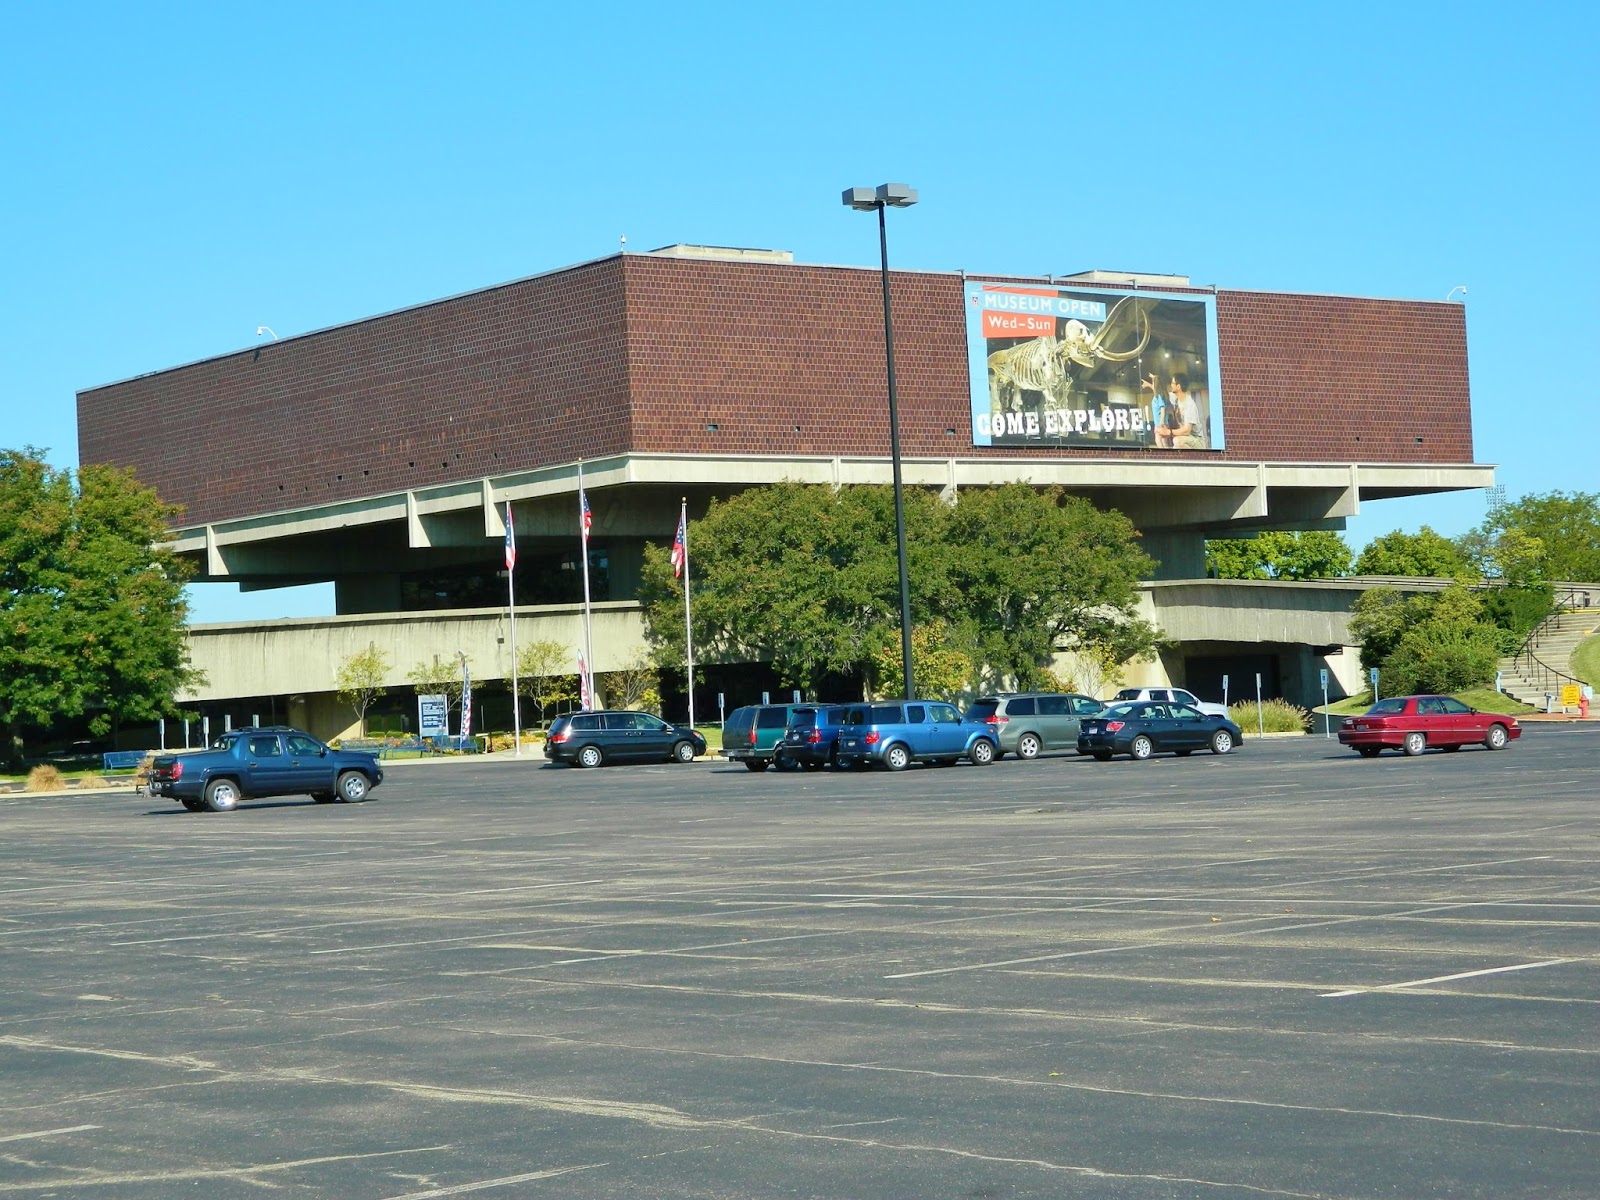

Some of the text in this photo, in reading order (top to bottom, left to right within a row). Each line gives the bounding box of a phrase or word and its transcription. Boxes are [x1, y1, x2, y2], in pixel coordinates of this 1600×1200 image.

[985, 294, 1100, 316] MUSEUM OPEN
[988, 316, 1051, 330] Wed-Sun
[976, 405, 1152, 437] COME EXPLORE!
